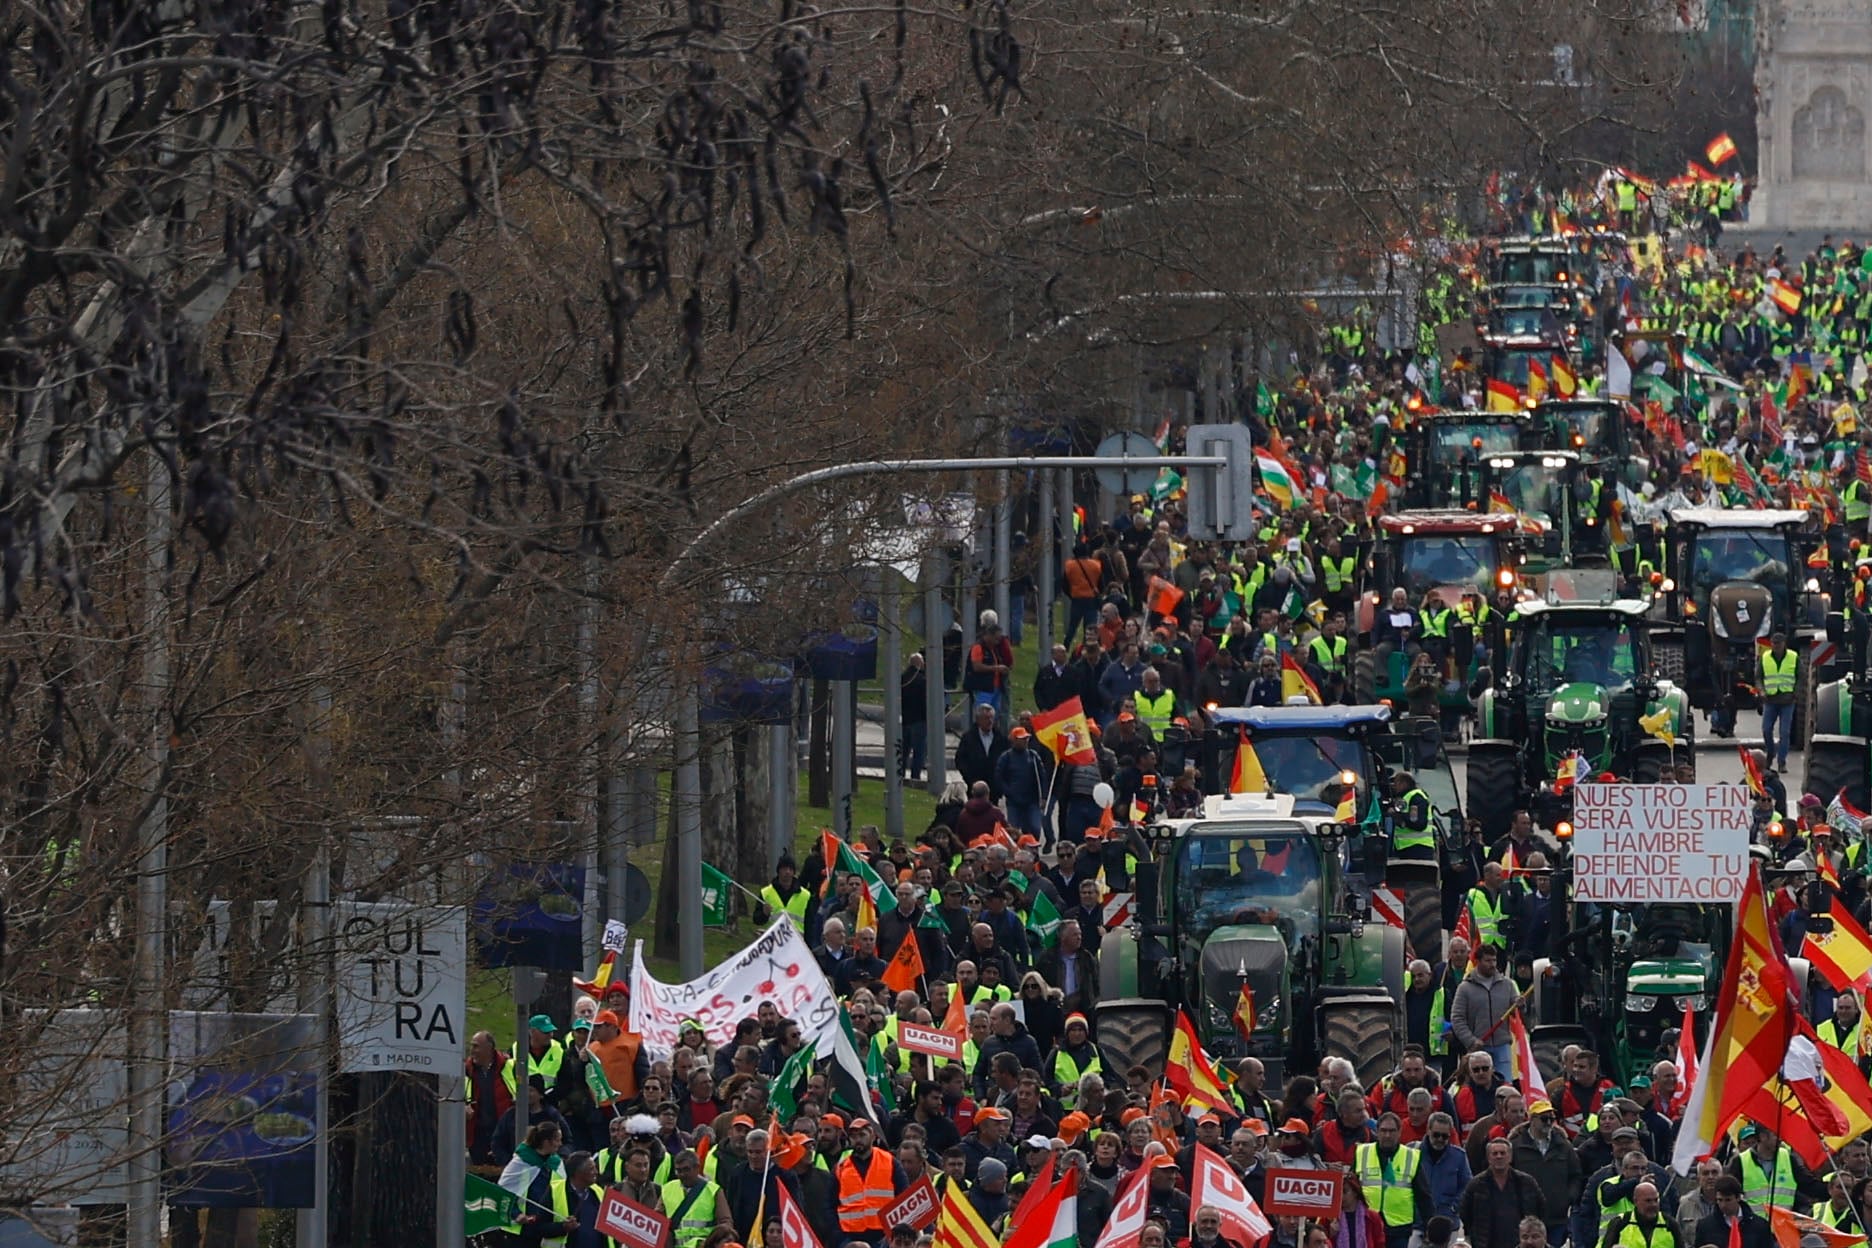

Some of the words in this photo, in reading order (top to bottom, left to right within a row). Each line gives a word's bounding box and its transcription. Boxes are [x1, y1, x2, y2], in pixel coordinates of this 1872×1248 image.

[1574, 786, 1688, 808] NUESTRO
[1705, 786, 1748, 808] FIN
[1574, 808, 1634, 830] SERA
[1643, 808, 1750, 830] VUESTRA
[1603, 832, 1705, 853] HAMBRE
[1574, 854, 1681, 876] DEFIENDE
[1706, 854, 1742, 876] TU
[1574, 876, 1747, 899] ALIMENTACION
[343, 916, 441, 956] CUL
[360, 958, 424, 998] TU
[395, 1001, 457, 1045] RA
[906, 1028, 956, 1047] UAGN
[386, 1053, 433, 1066] MADRID
[1275, 1179, 1335, 1197] UAGN
[885, 1186, 931, 1227] UAGN
[610, 1200, 661, 1238] UAGN
